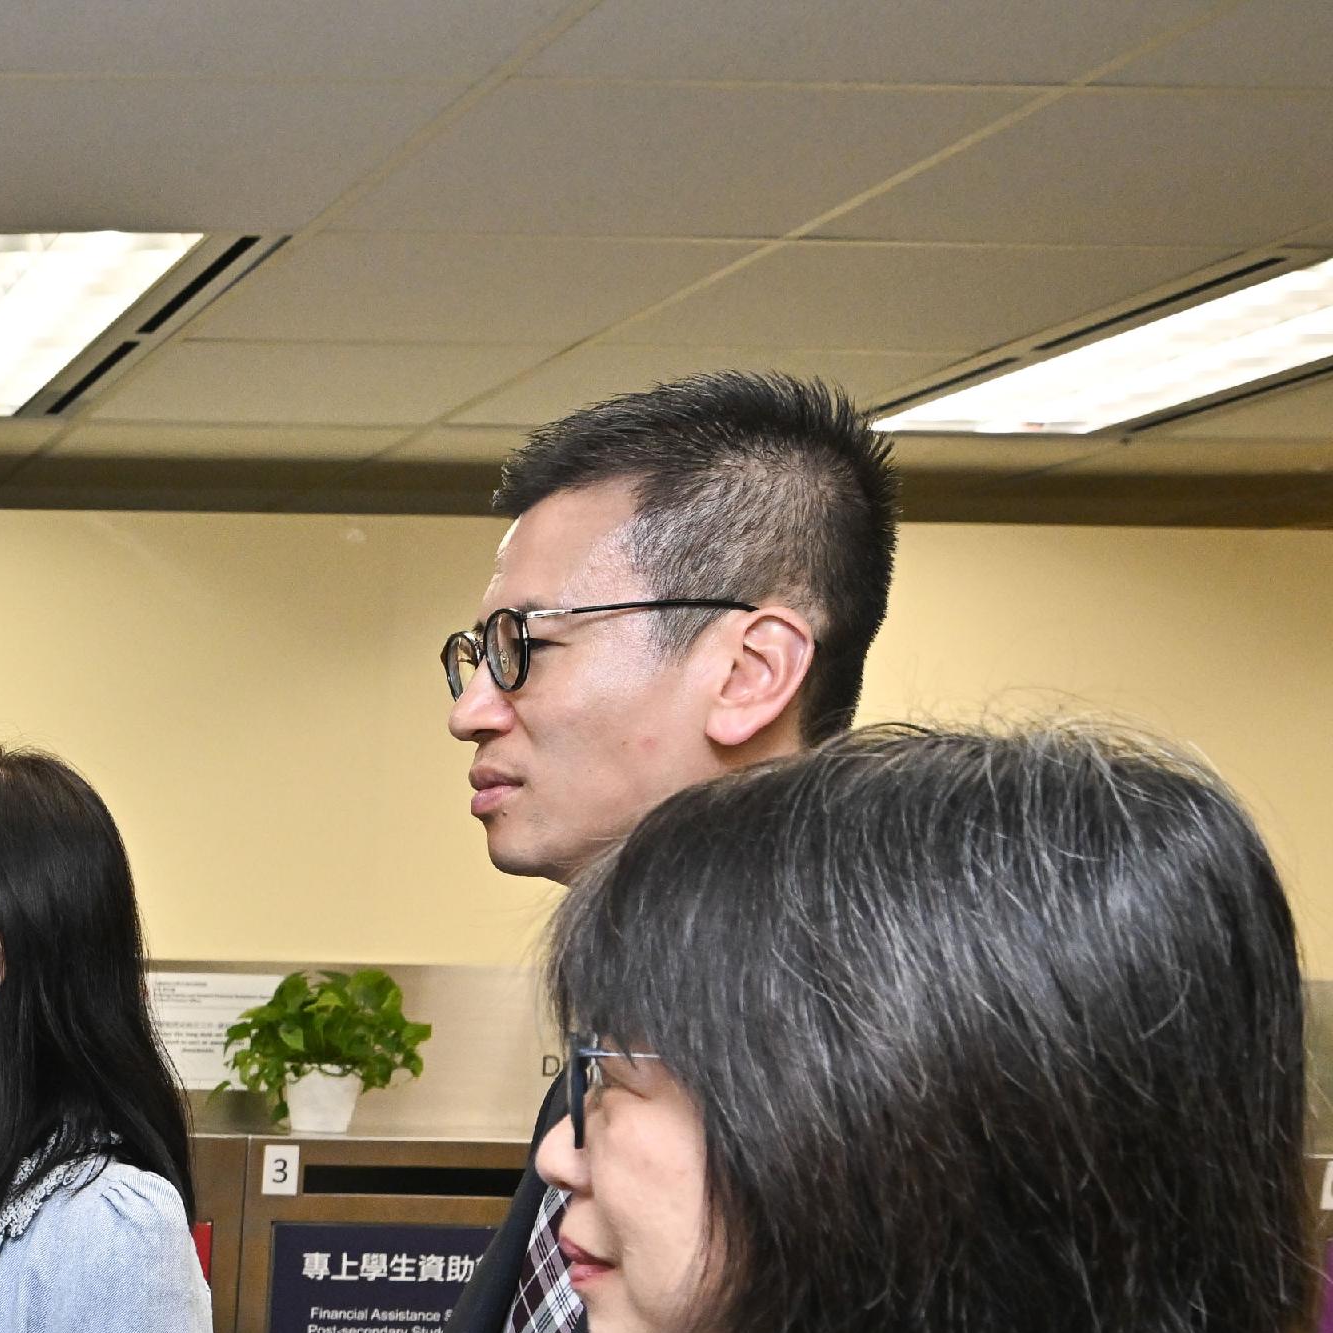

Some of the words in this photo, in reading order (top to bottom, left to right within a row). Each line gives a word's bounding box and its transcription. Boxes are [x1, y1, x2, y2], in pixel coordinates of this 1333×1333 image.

[272, 1158, 288, 1183] 3
[302, 1252, 484, 1282] 專上學生資助
[310, 1306, 368, 1321] Financial
[371, 1308, 441, 1322] Assistance
